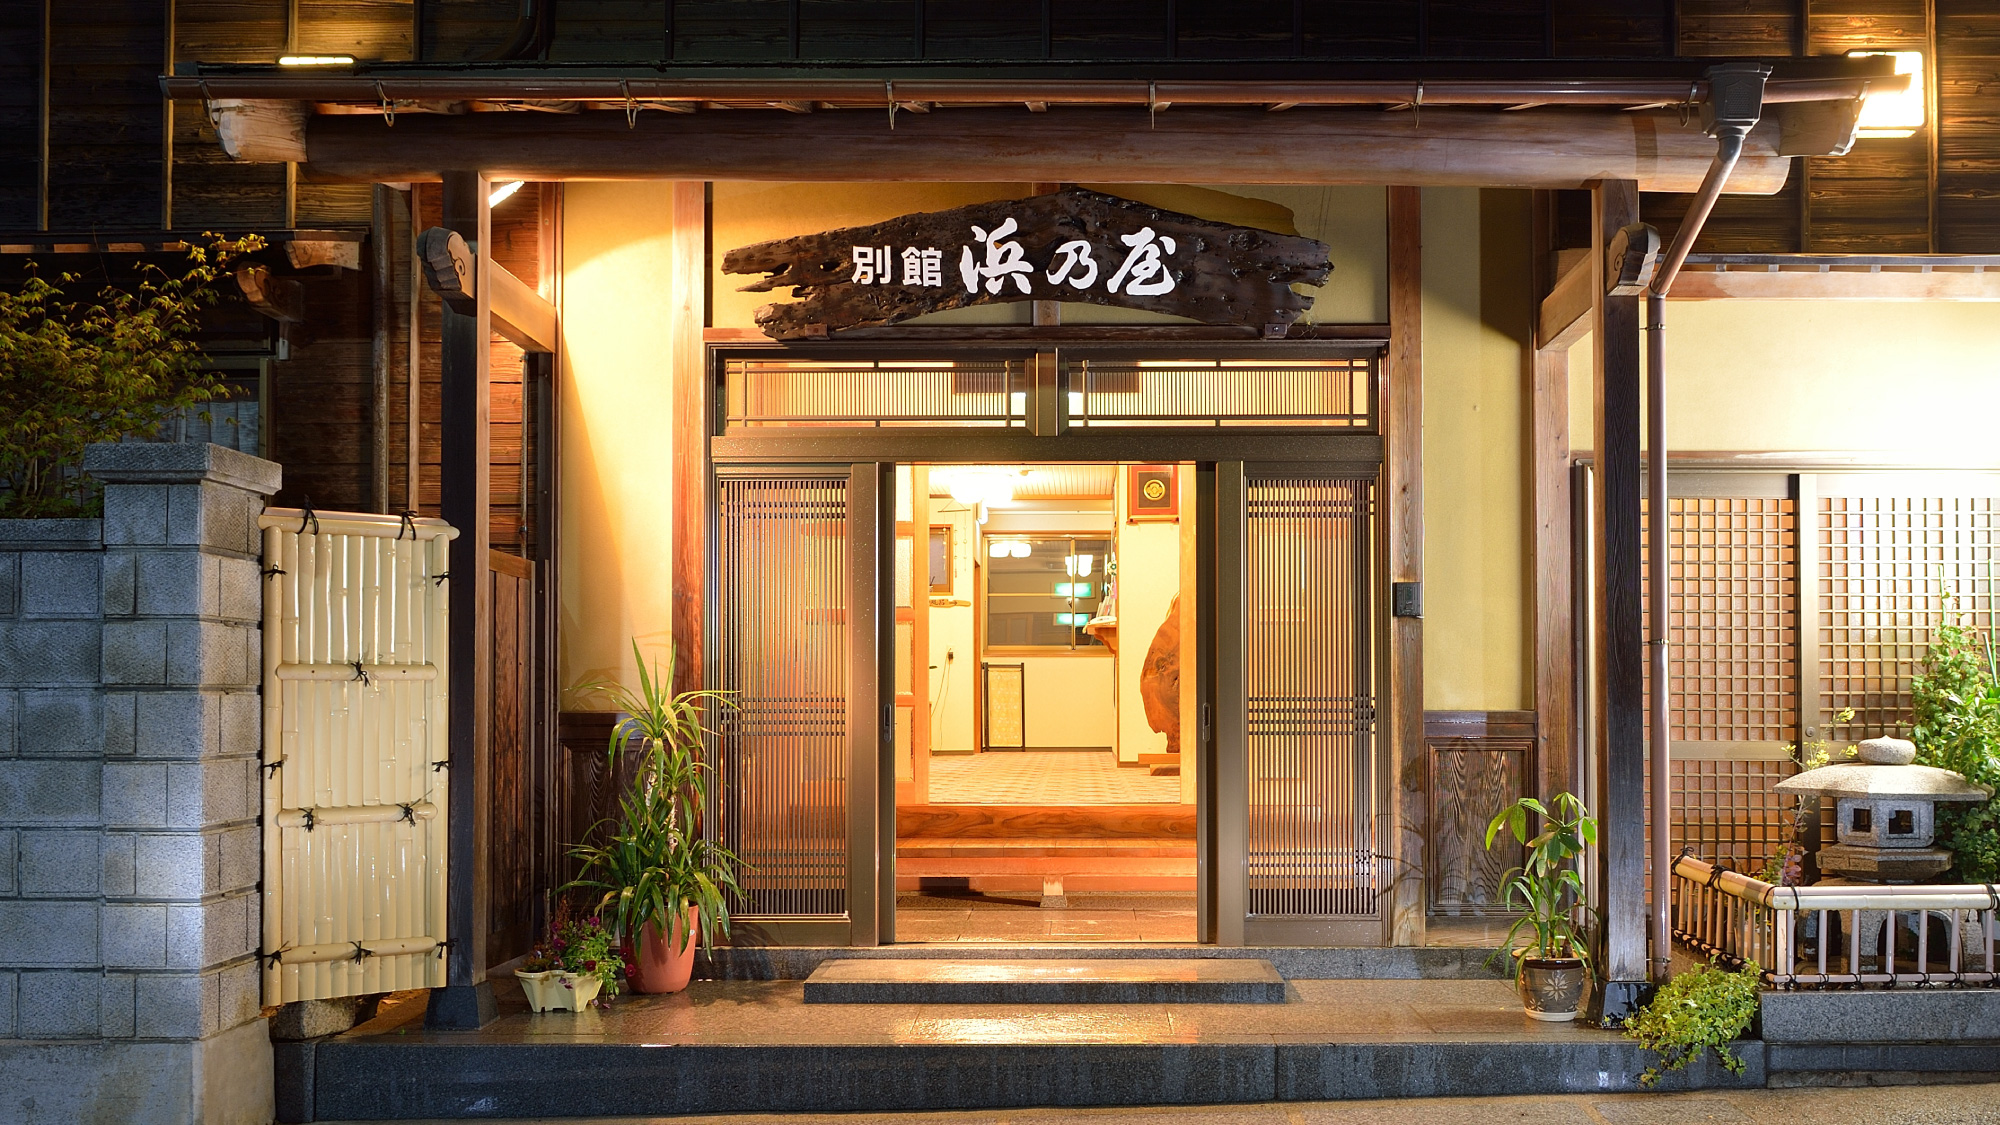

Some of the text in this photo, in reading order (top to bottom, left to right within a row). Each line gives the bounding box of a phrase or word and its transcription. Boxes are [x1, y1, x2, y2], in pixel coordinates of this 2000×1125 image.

[851, 217, 1177, 296] 別館 浜乃屋
